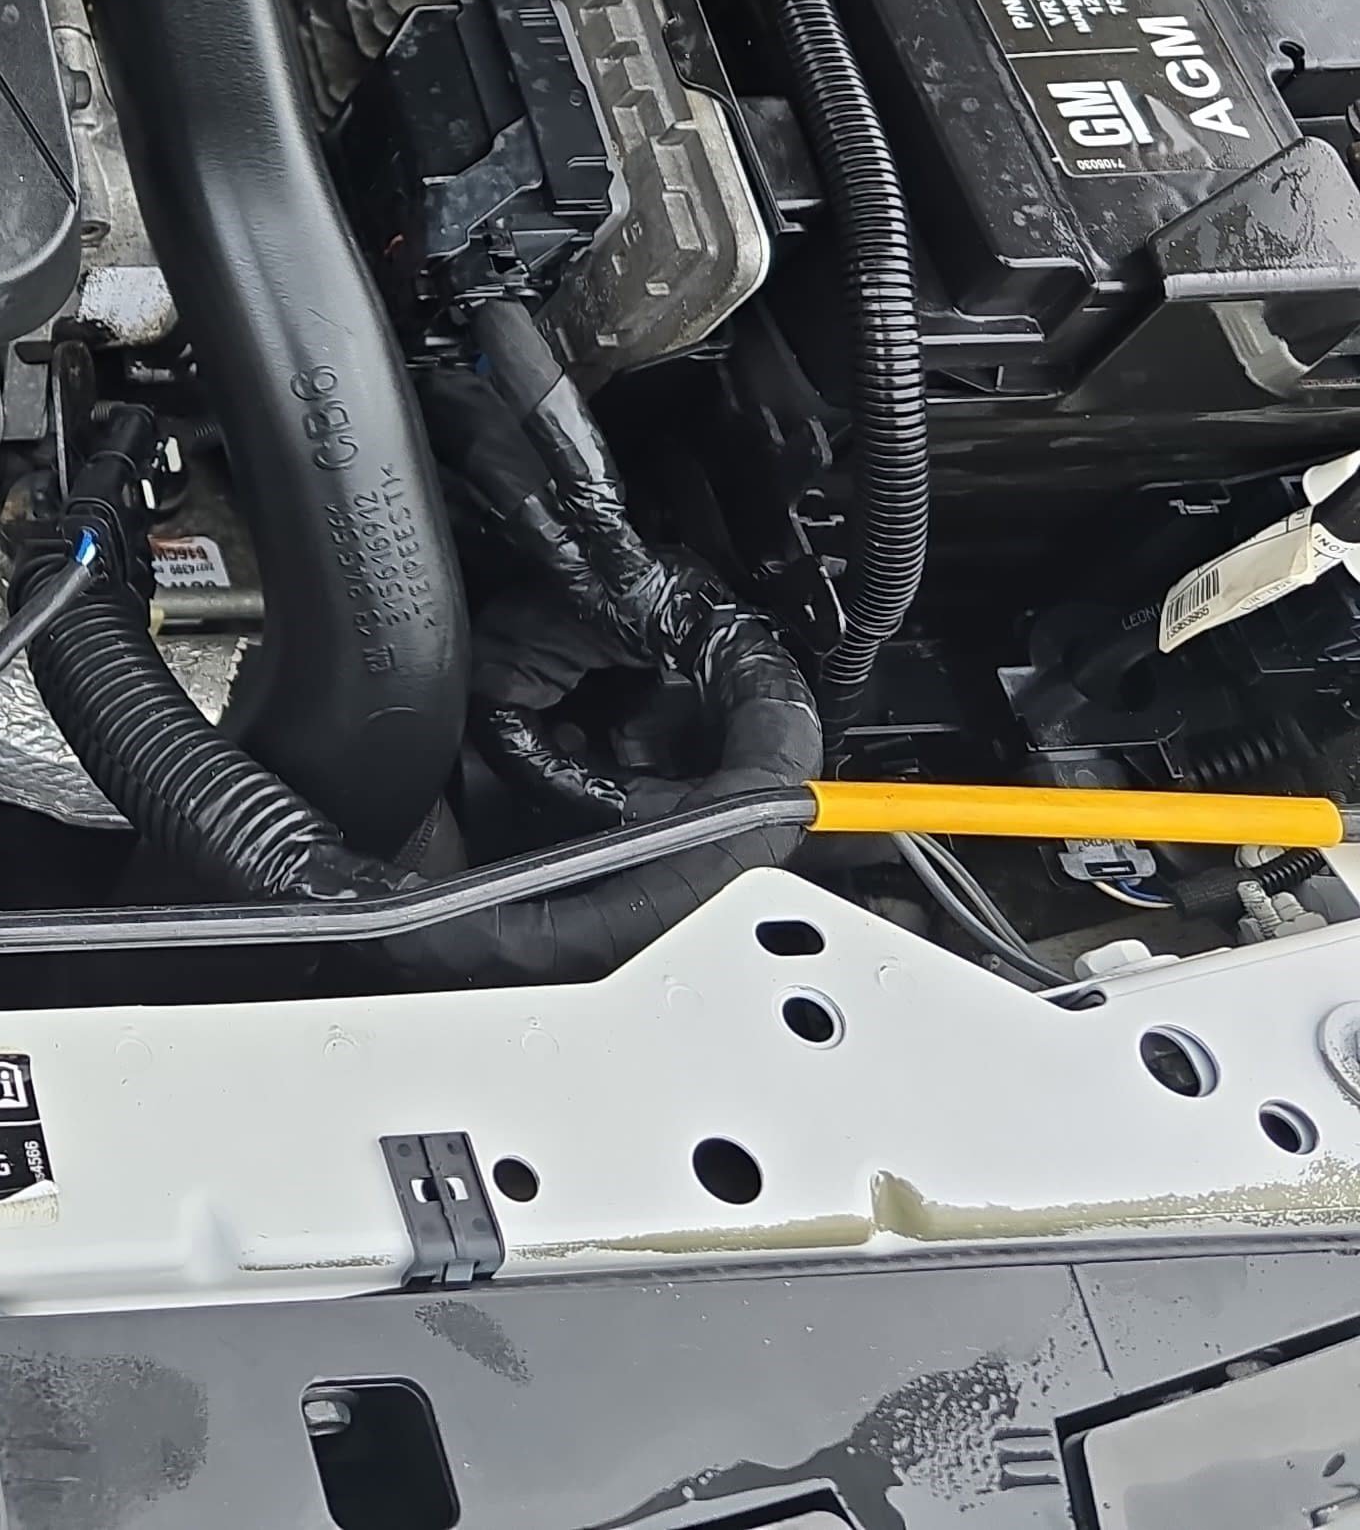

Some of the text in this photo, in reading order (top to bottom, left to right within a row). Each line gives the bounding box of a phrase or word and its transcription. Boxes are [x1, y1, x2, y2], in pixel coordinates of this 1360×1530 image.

[1046, 80, 1133, 148] GM
[1136, 15, 1251, 140] AGM
[289, 364, 360, 471] CB6
